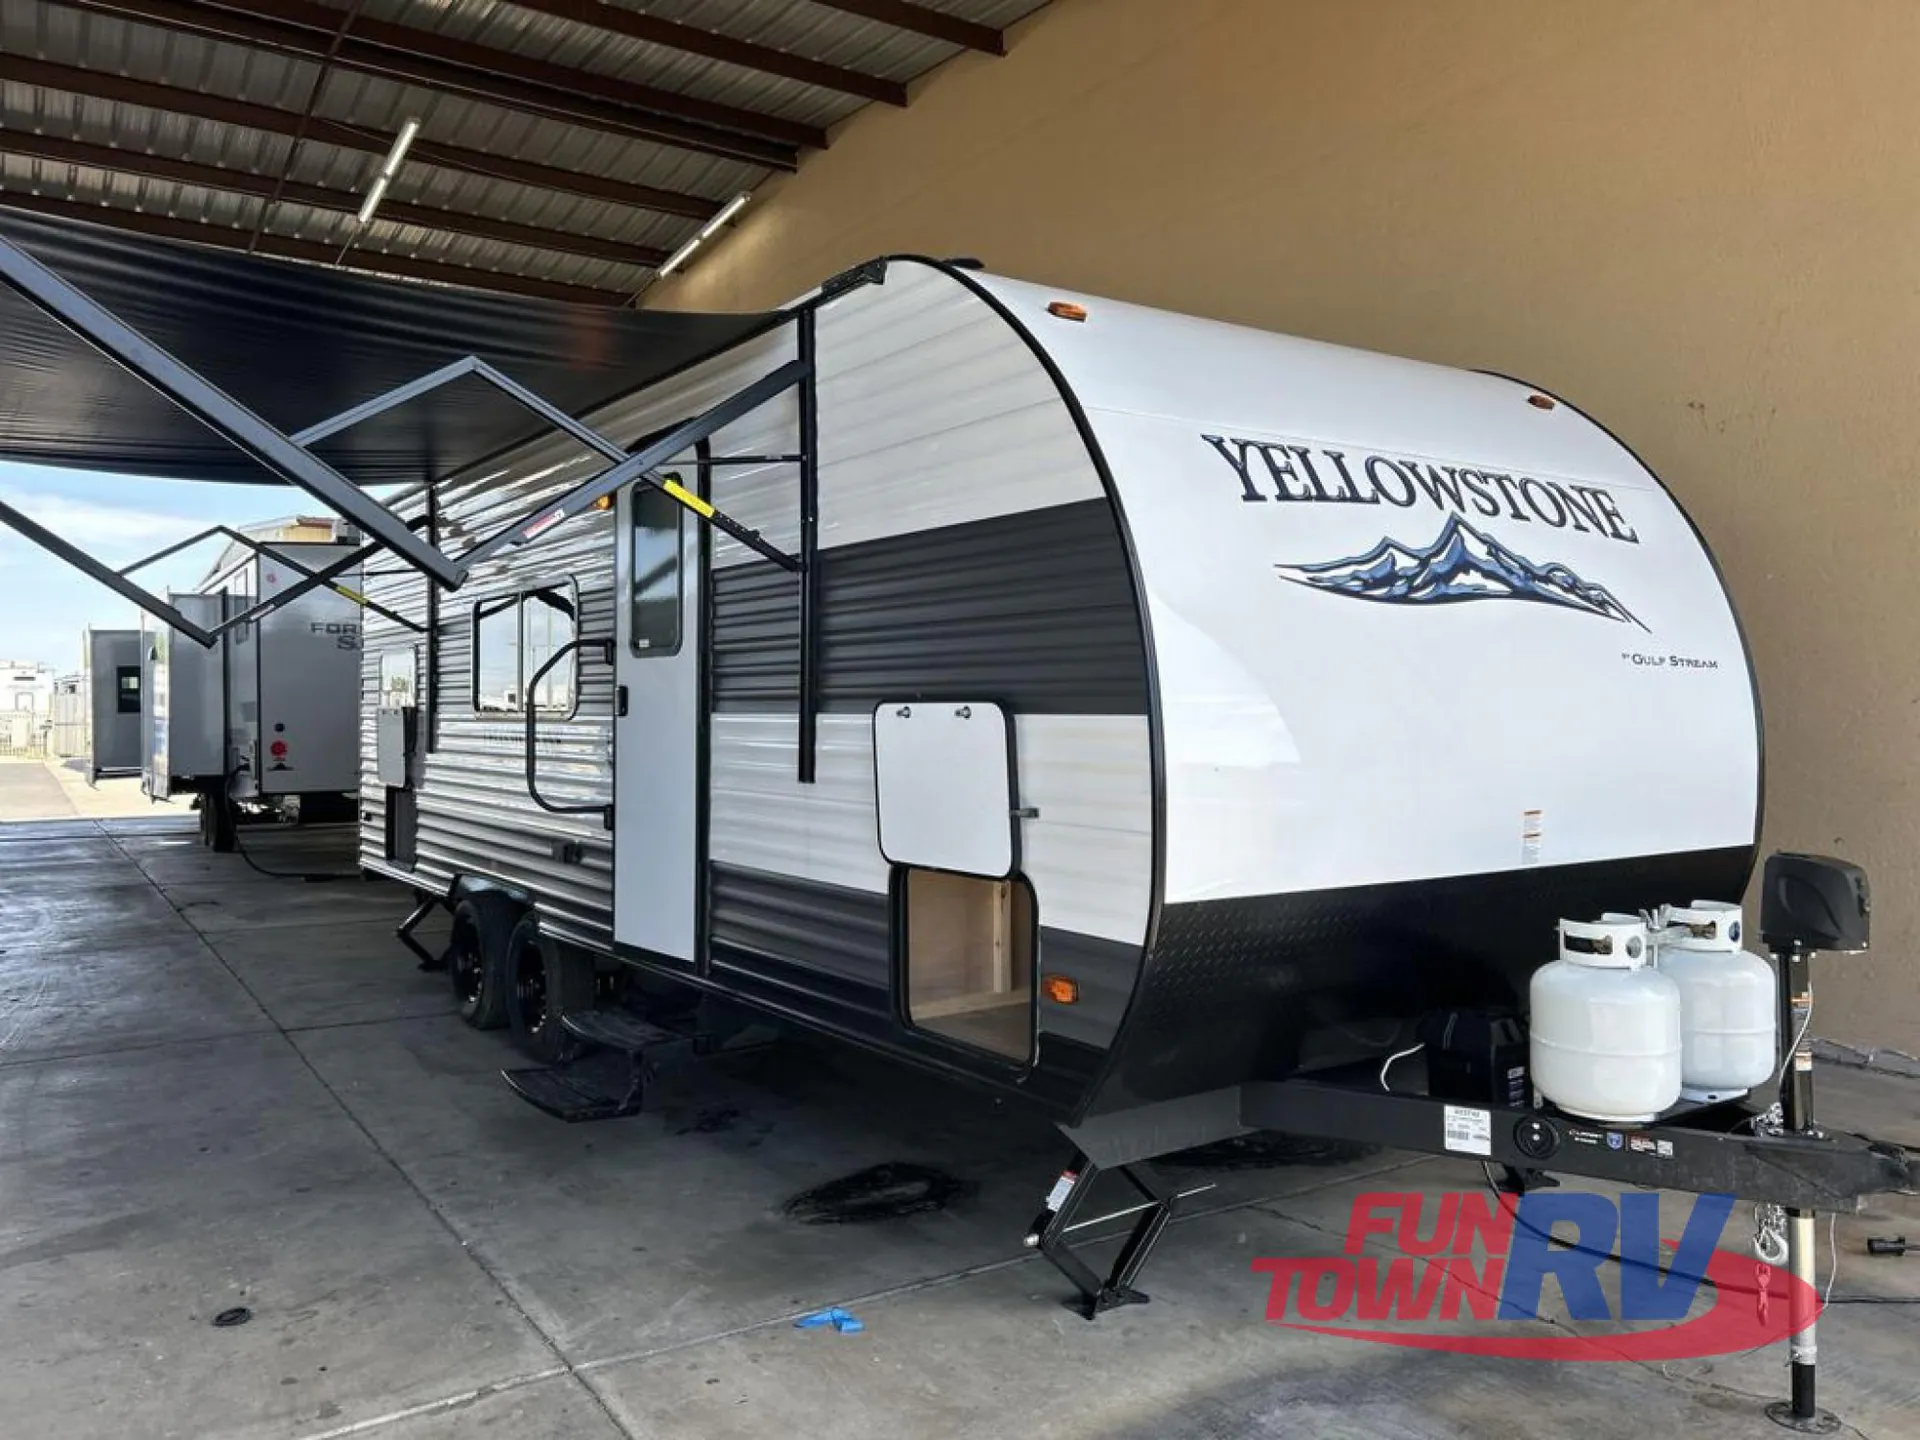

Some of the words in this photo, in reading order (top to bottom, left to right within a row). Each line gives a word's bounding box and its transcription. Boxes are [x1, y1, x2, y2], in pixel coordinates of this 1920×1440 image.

[1201, 434, 1640, 544] YELLOWSTONE
[1632, 653, 1666, 666] GULF
[1669, 655, 1719, 669] STREAM
